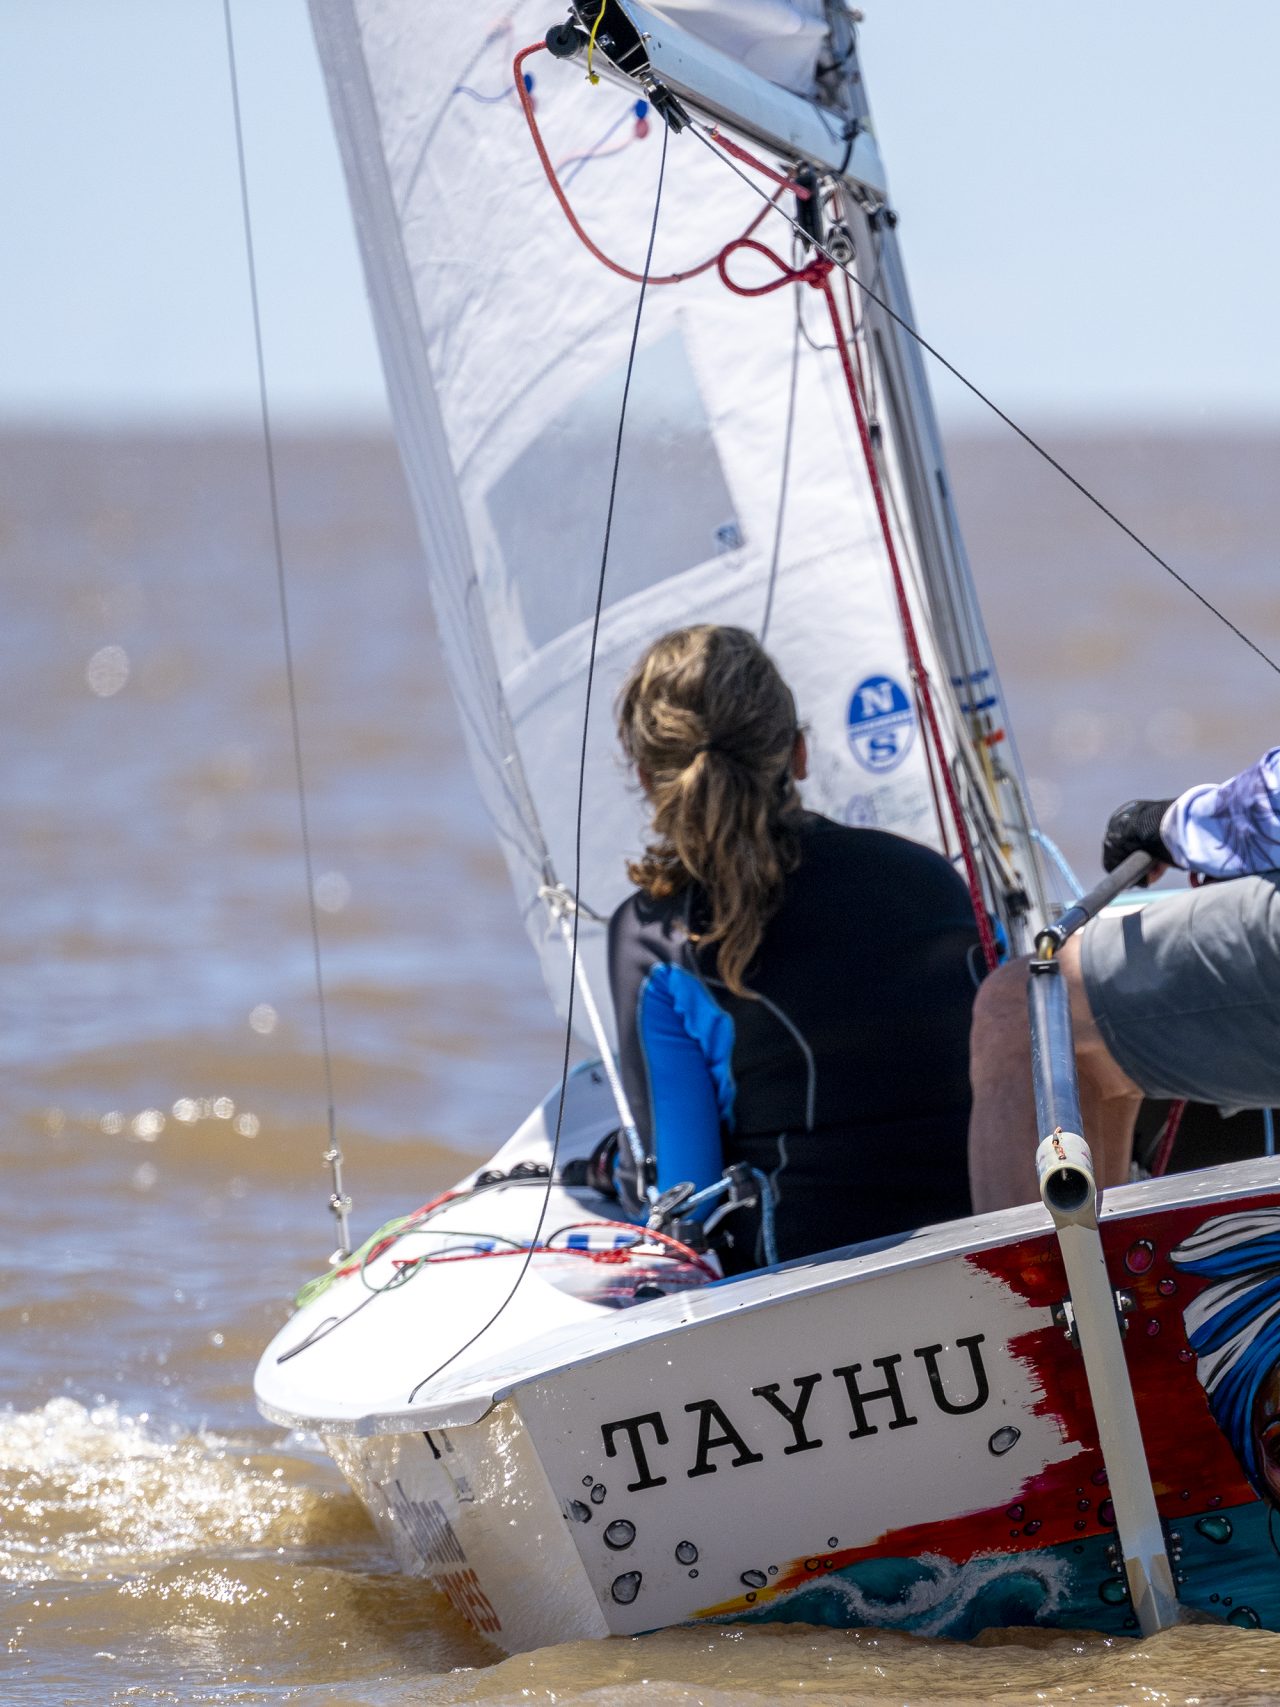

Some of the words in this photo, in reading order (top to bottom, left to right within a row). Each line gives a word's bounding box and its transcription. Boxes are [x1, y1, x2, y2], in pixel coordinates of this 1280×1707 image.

[860, 682, 895, 717] N
[869, 731, 898, 762] S
[600, 1333, 990, 1493] TAYHU
